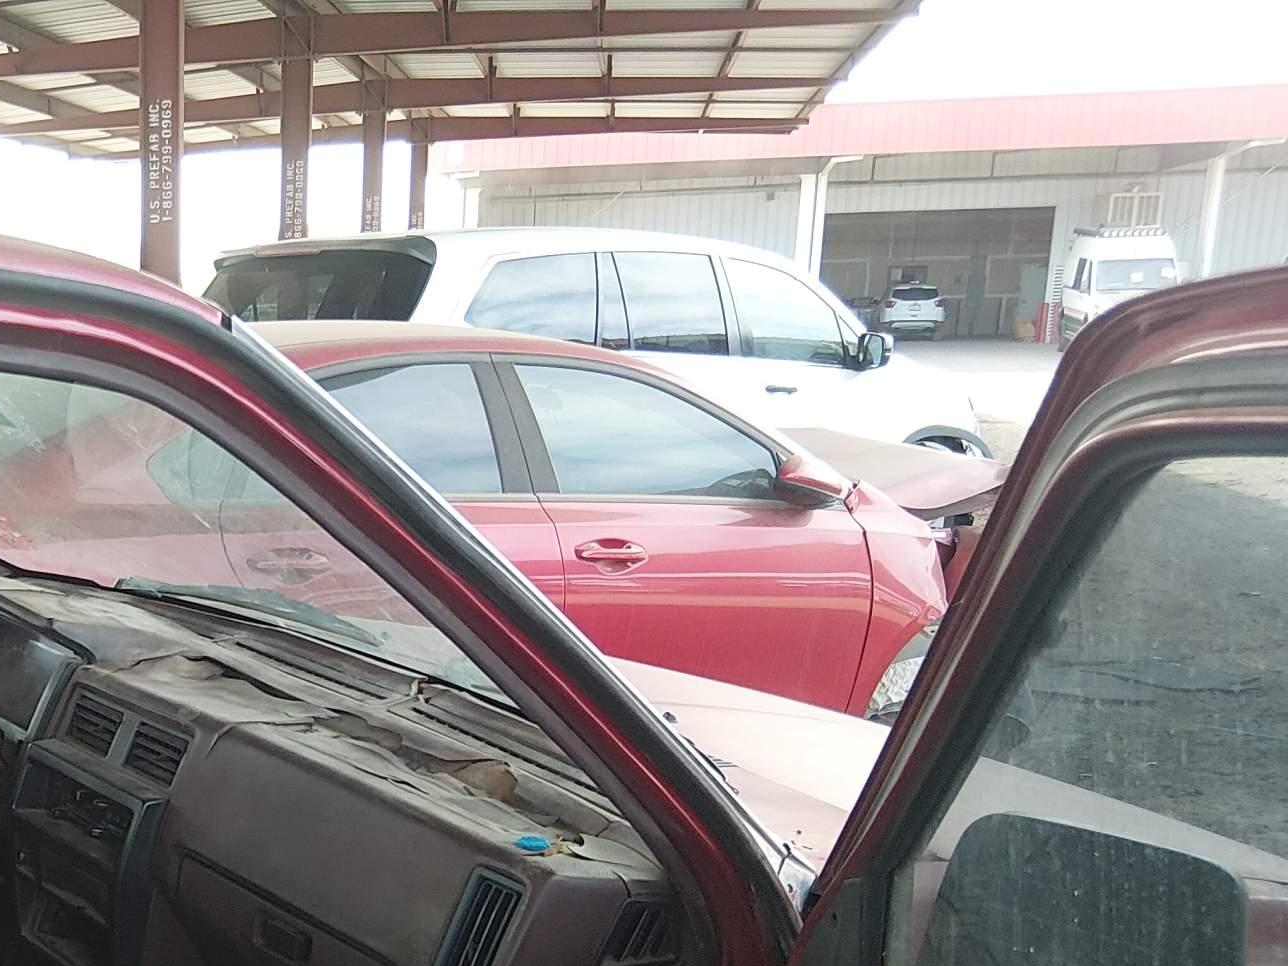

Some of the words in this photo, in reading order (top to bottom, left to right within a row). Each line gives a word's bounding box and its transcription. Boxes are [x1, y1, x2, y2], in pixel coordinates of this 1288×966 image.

[148, 98, 161, 127] INC.
[148, 133, 161, 189] PREFAB
[161, 99, 173, 221] 1-866-799-0969
[149, 196, 161, 224] U.S.
[285, 184, 294, 224] PREFAB
